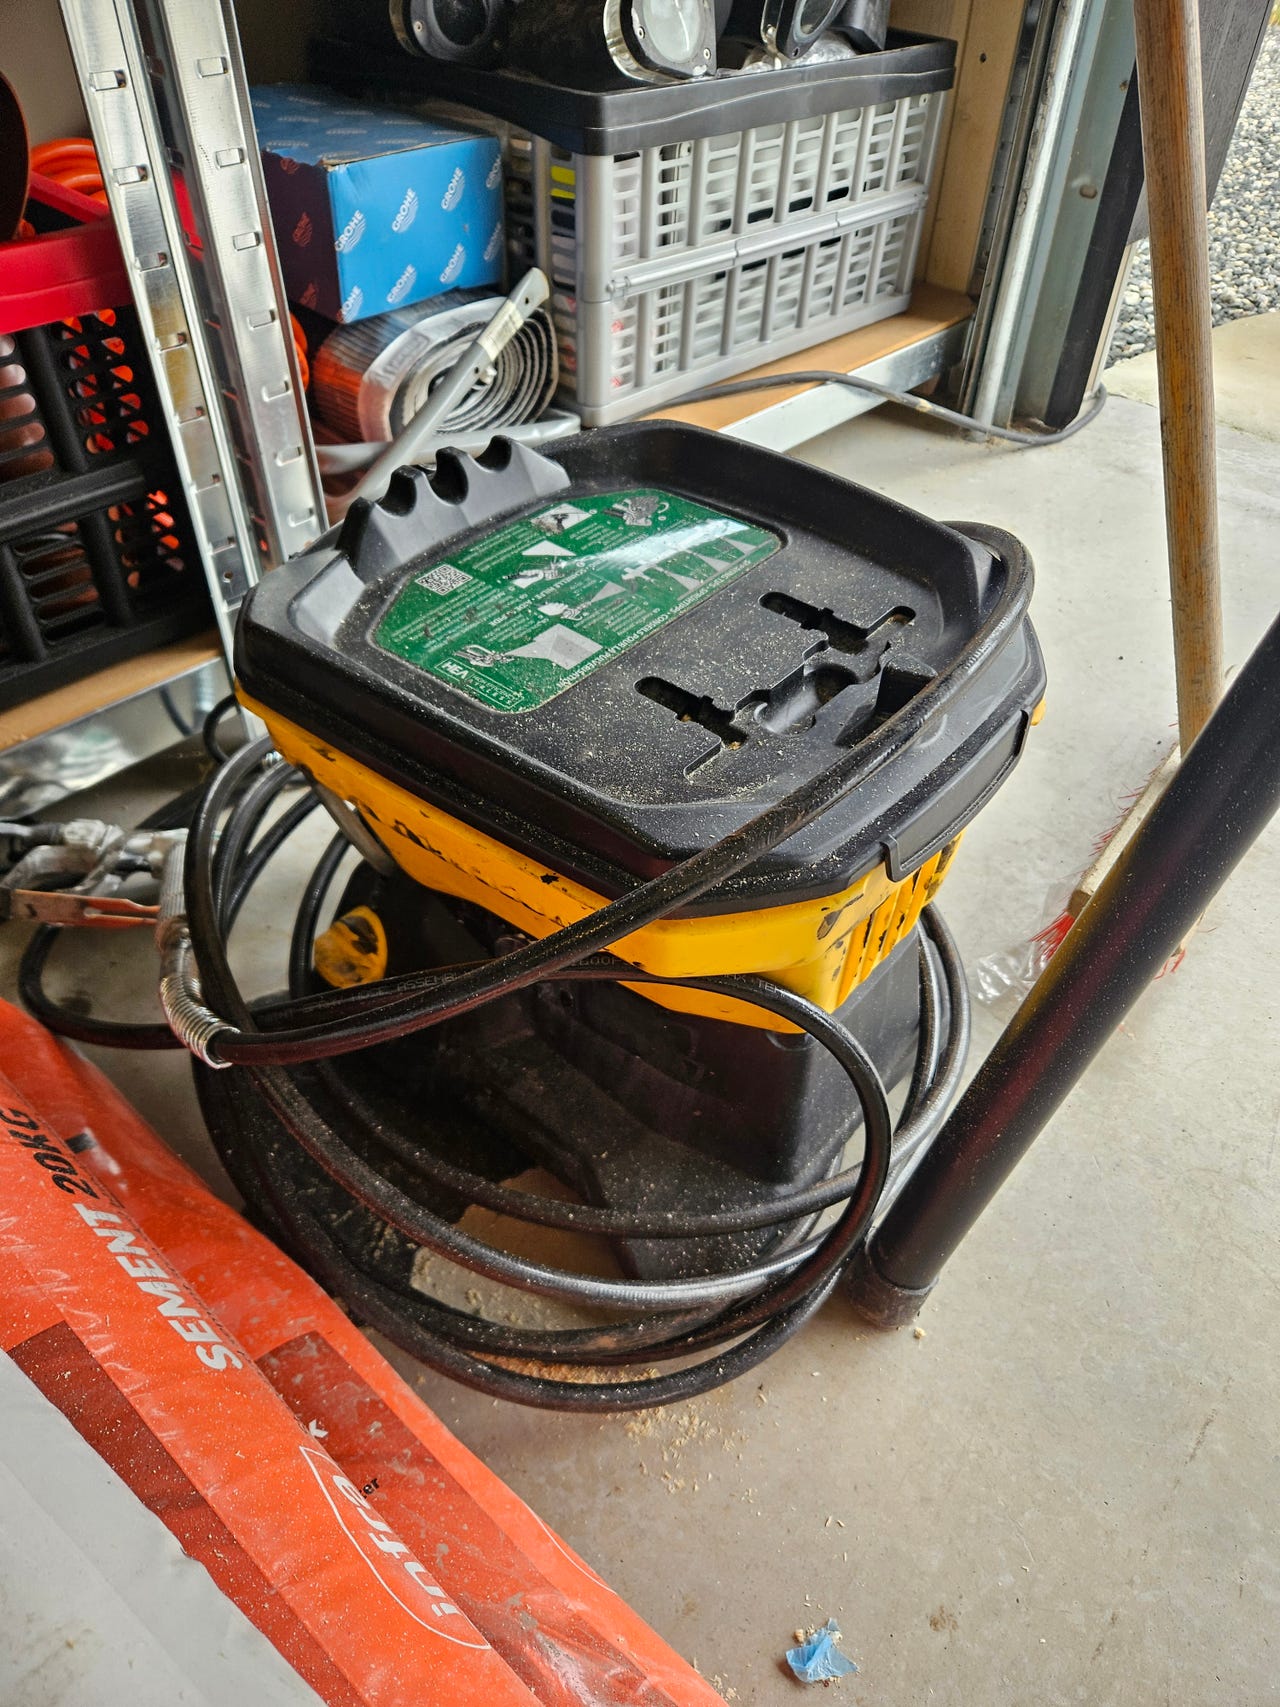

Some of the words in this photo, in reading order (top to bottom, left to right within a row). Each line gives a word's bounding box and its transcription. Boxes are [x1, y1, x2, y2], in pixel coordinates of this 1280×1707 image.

[391, 187, 417, 232] GROHE
[441, 167, 463, 210] GROHE
[334, 209, 364, 252] GROHE
[387, 263, 415, 304] GROHE
[439, 243, 464, 283] GROHE
[617, 633, 640, 649] POUR
[640, 613, 669, 635] CONSEILS
[0, 1107, 100, 1200] 20KG
[74, 1202, 245, 1371] SEMENT
[333, 1475, 462, 1617] infra
